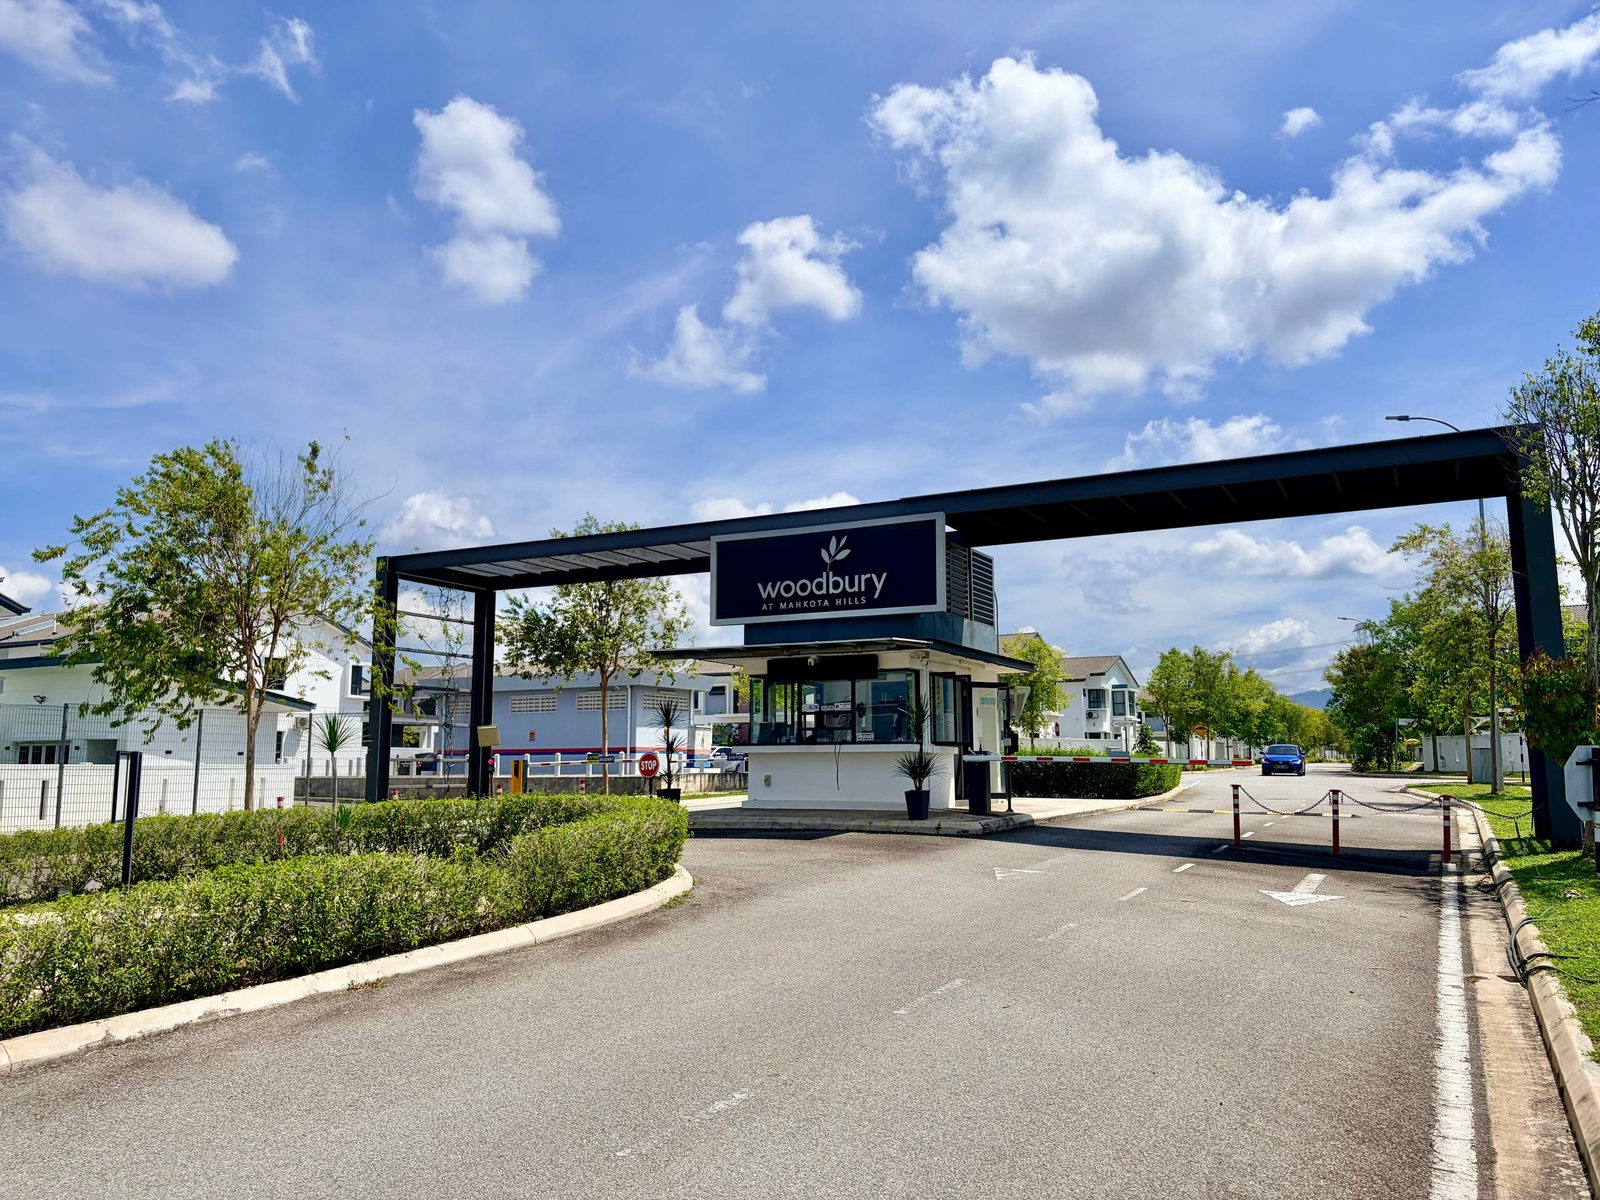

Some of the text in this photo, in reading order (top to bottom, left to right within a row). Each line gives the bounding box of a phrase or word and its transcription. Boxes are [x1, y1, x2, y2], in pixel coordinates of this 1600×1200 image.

[757, 571, 887, 599] woodbury
[761, 596, 867, 611] AT MAHKOTA HILLS
[640, 760, 657, 770] STOP
